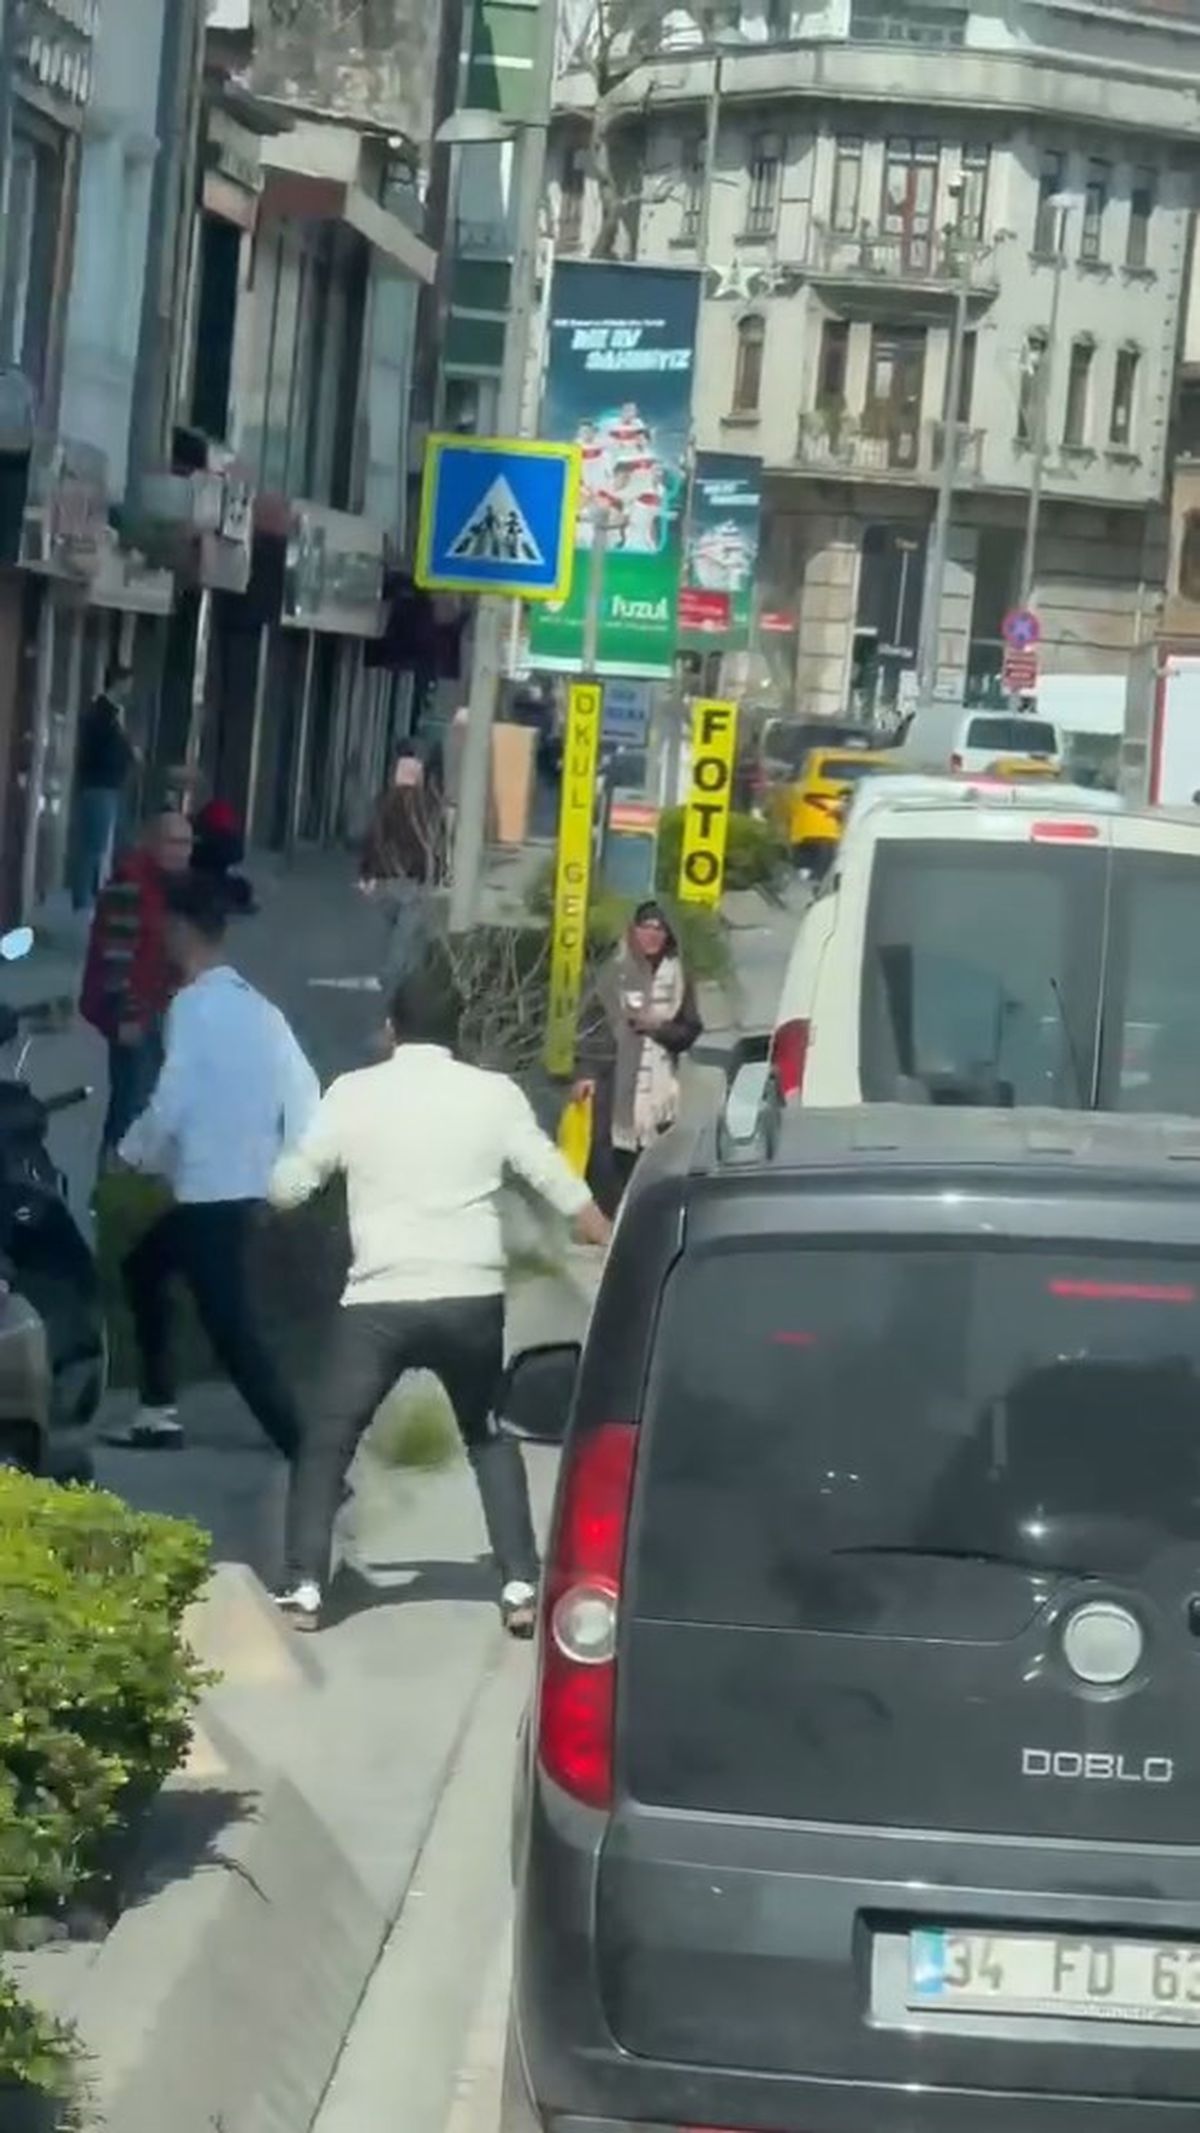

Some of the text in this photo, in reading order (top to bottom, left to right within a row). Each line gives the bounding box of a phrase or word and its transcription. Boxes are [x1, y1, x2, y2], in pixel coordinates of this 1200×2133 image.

[571, 692, 596, 809] OKUL
[685, 709, 730, 886] FOTO
[1022, 1748, 1173, 1782] DOBLO
[945, 1937, 1003, 1989] 34
[1053, 1940, 1114, 1996] FD
